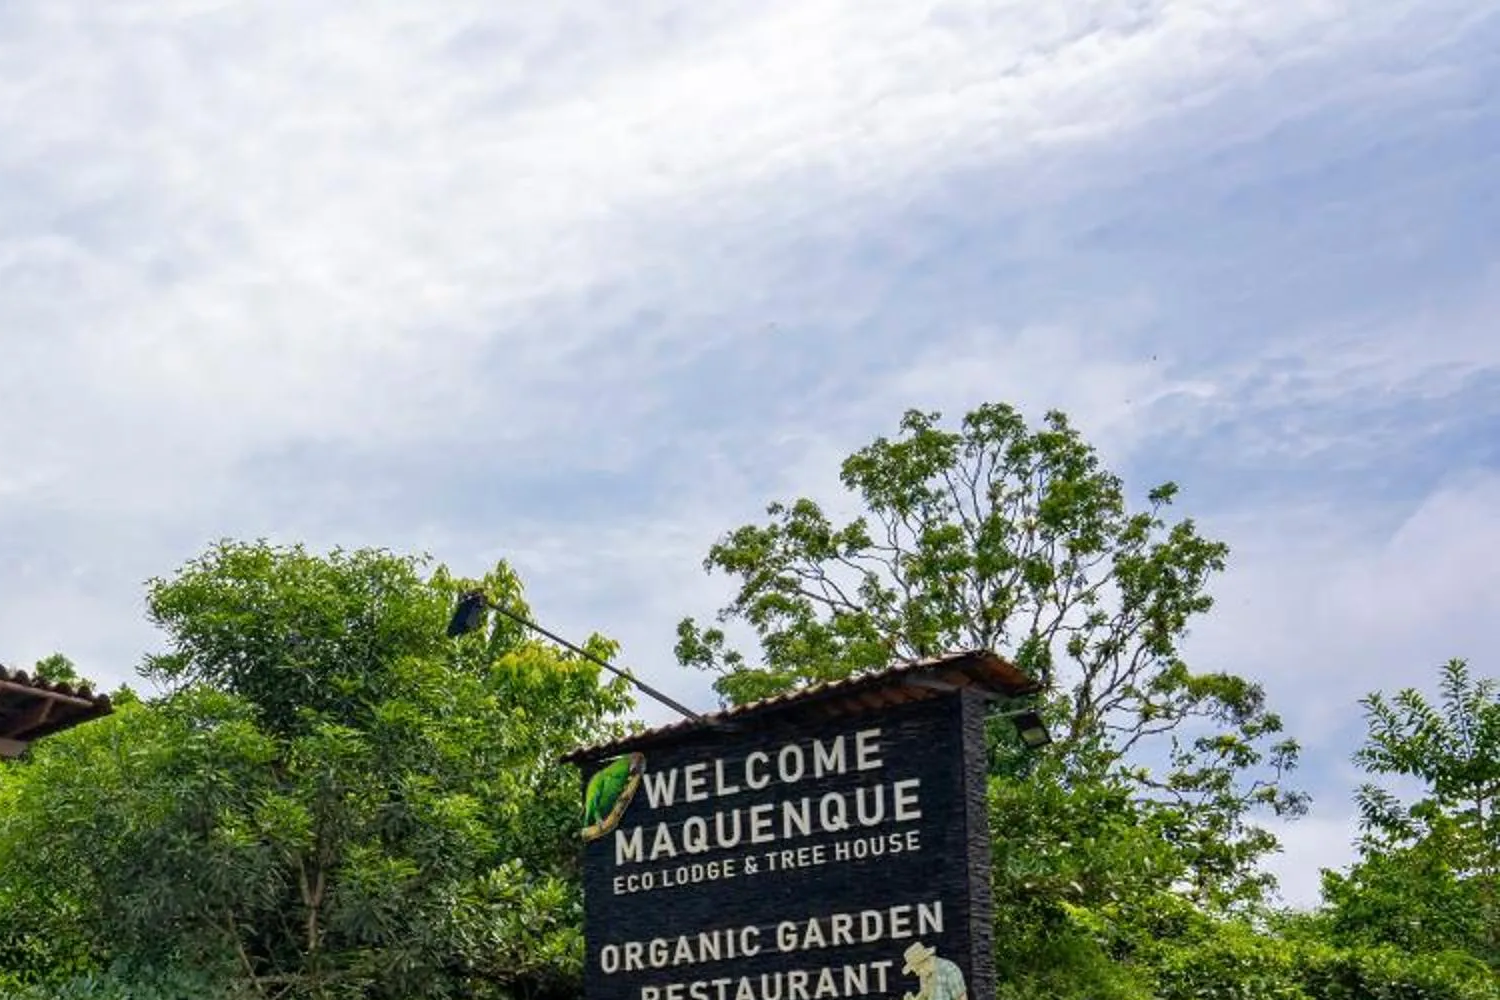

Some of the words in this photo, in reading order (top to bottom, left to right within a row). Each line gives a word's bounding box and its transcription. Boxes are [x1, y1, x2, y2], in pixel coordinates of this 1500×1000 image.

[643, 727, 884, 810] WELCOME
[614, 778, 923, 866] MAQUENQUE
[613, 871, 653, 896] ECO
[662, 859, 736, 888] LODGE
[744, 855, 759, 875] &
[765, 845, 827, 872] TREE
[835, 830, 922, 862] HOUSE
[600, 925, 761, 974] ORGANIC
[776, 901, 944, 953] GARDEN
